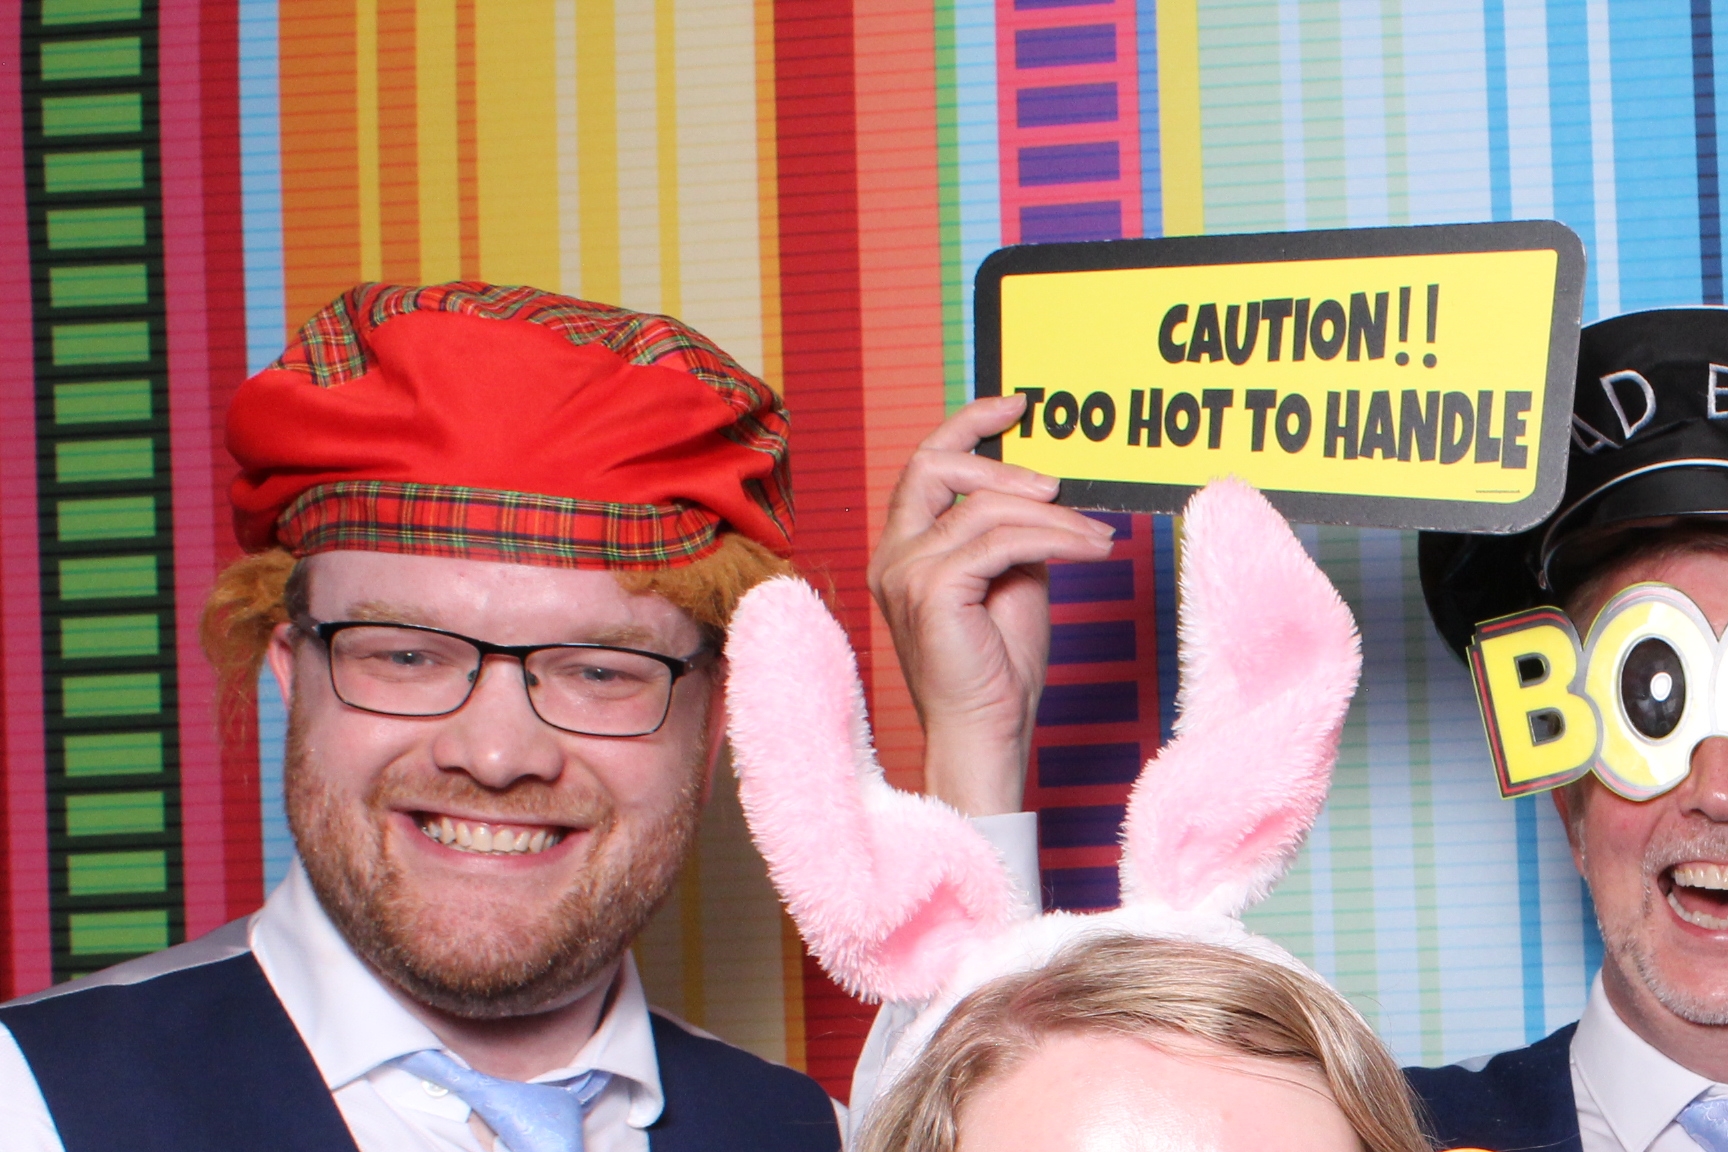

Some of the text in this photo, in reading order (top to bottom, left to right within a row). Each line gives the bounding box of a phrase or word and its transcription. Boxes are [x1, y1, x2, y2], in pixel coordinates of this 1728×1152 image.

[1158, 284, 1439, 368] CAUTION!!
[1014, 387, 1532, 469] TOO HOT TO HANDLE
[1571, 369, 1657, 453] AD
